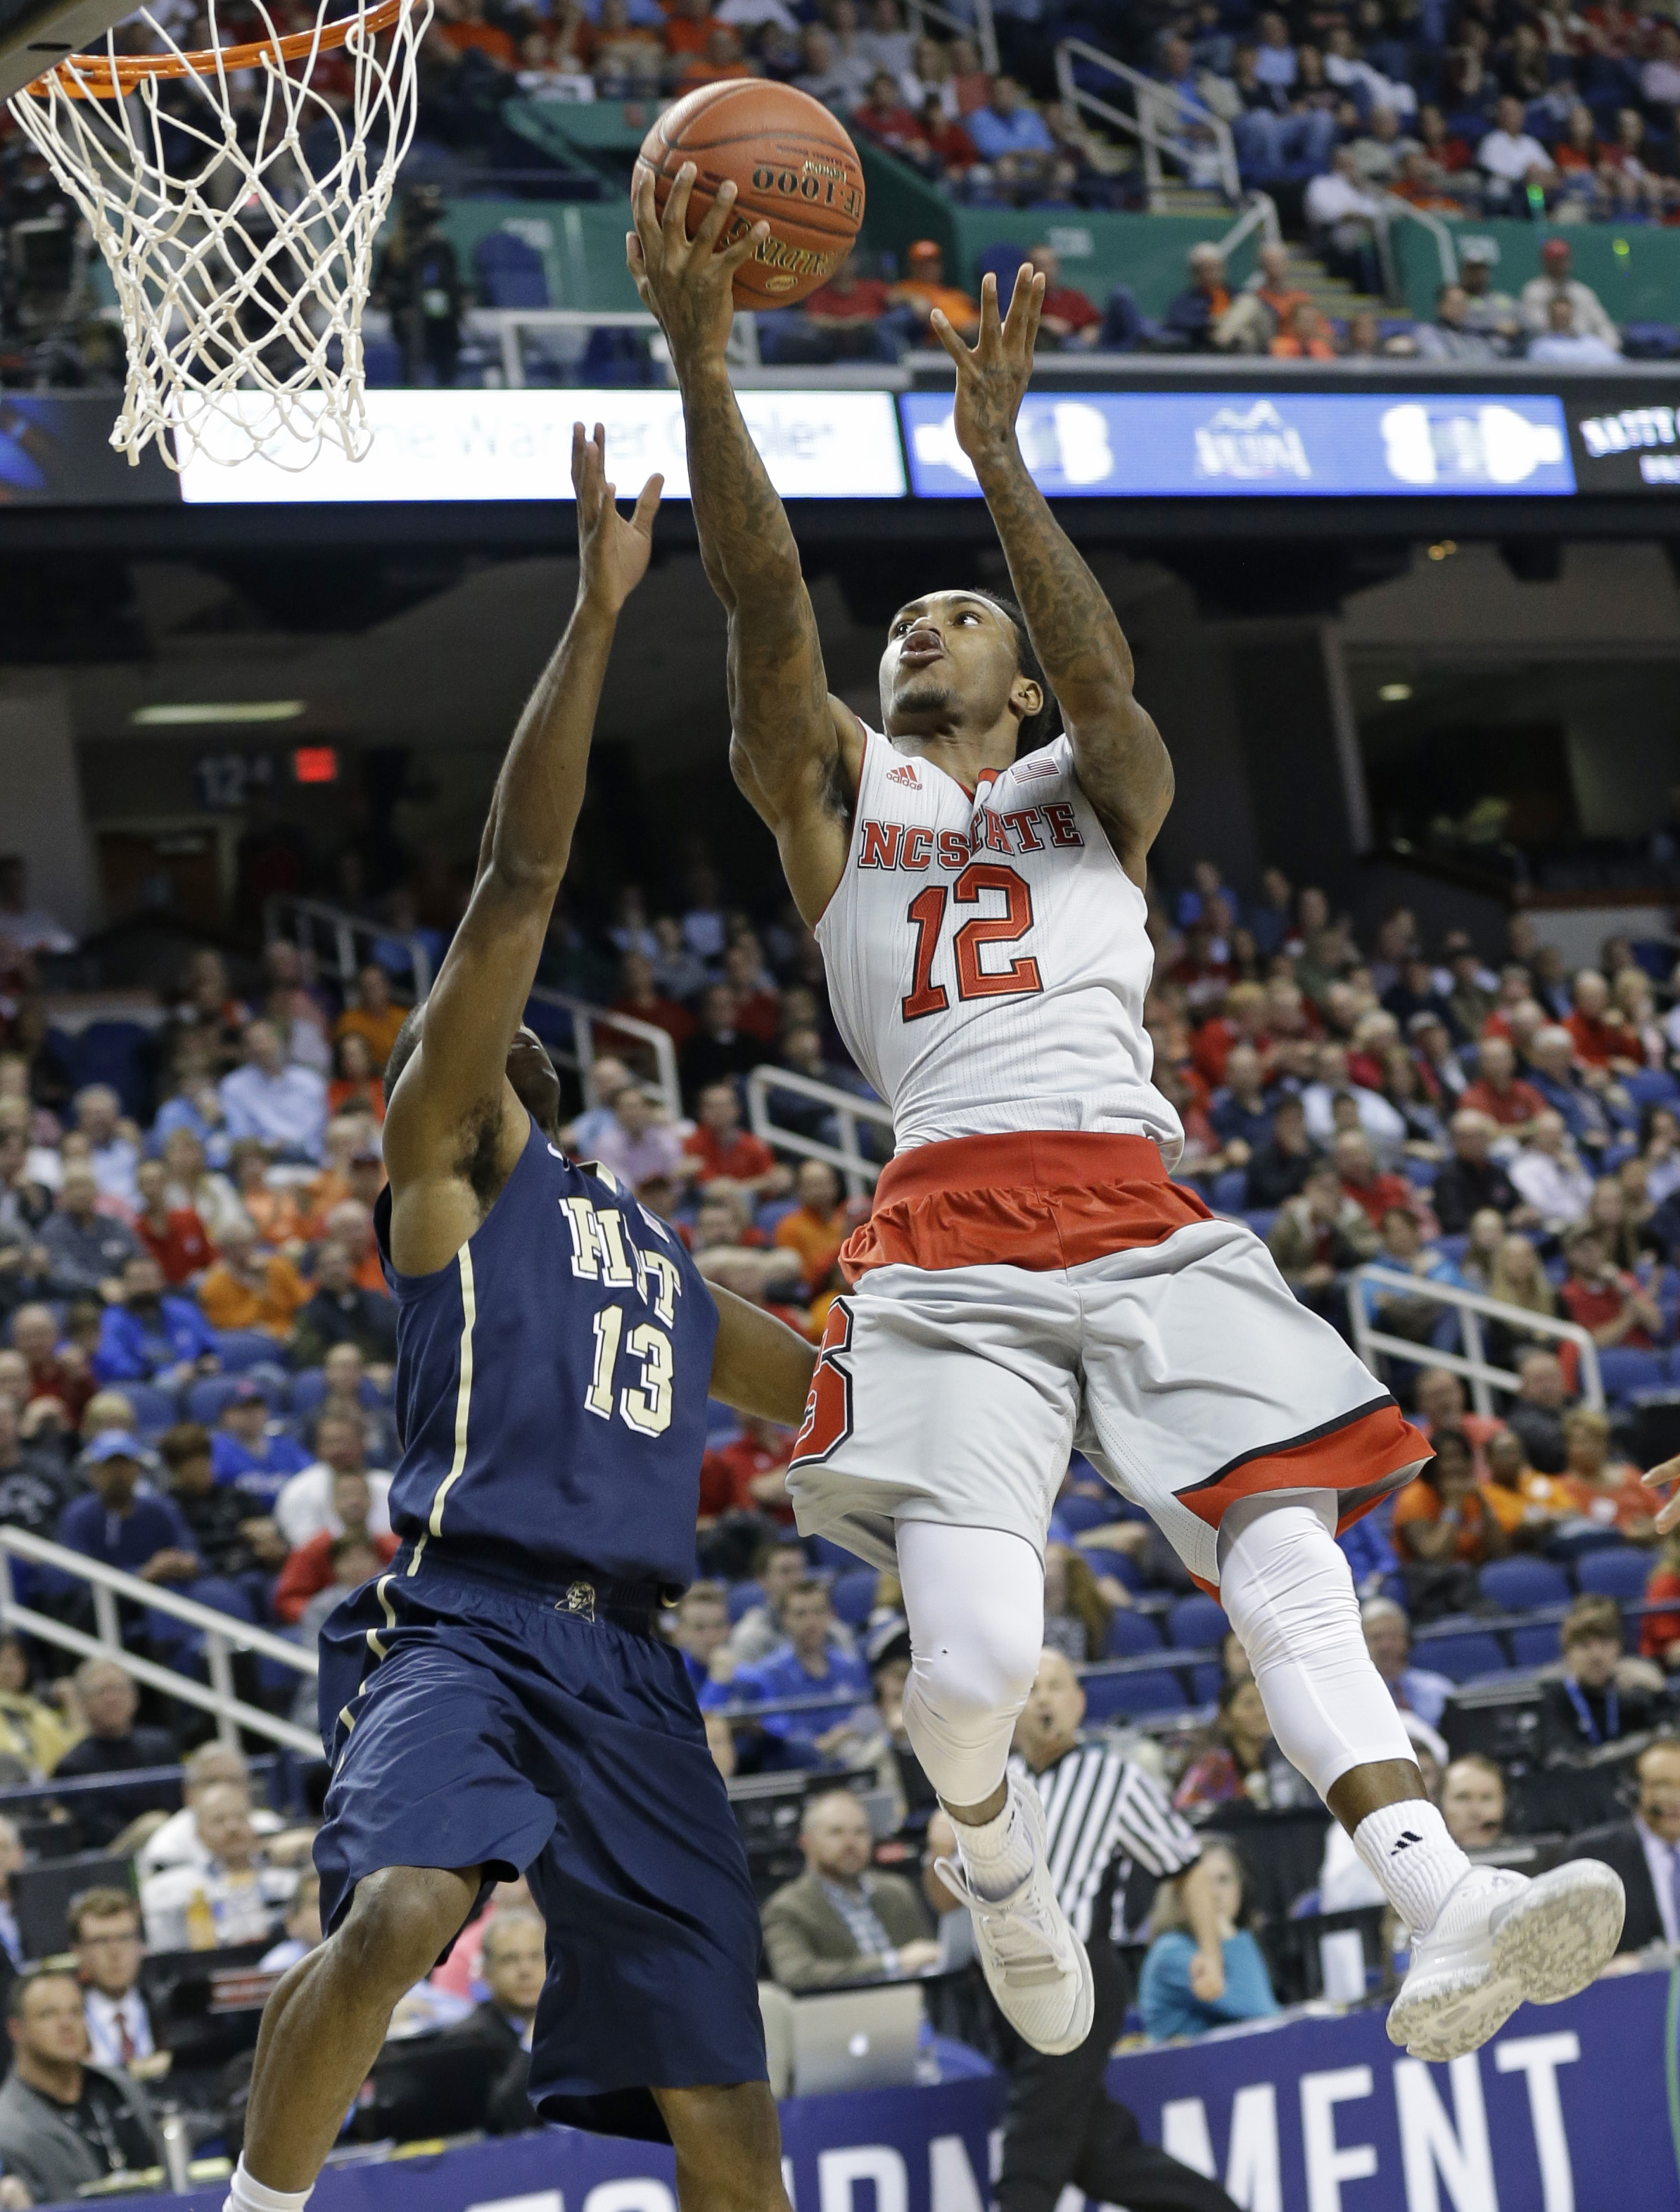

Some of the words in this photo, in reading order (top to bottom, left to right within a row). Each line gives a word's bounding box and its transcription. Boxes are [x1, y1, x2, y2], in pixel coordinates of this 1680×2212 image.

[455, 413, 651, 459] Warer
[886, 772, 923, 791] adidas
[901, 862, 1045, 1024] 12
[558, 1196, 682, 1330] PIT
[583, 1304, 675, 1439] 13
